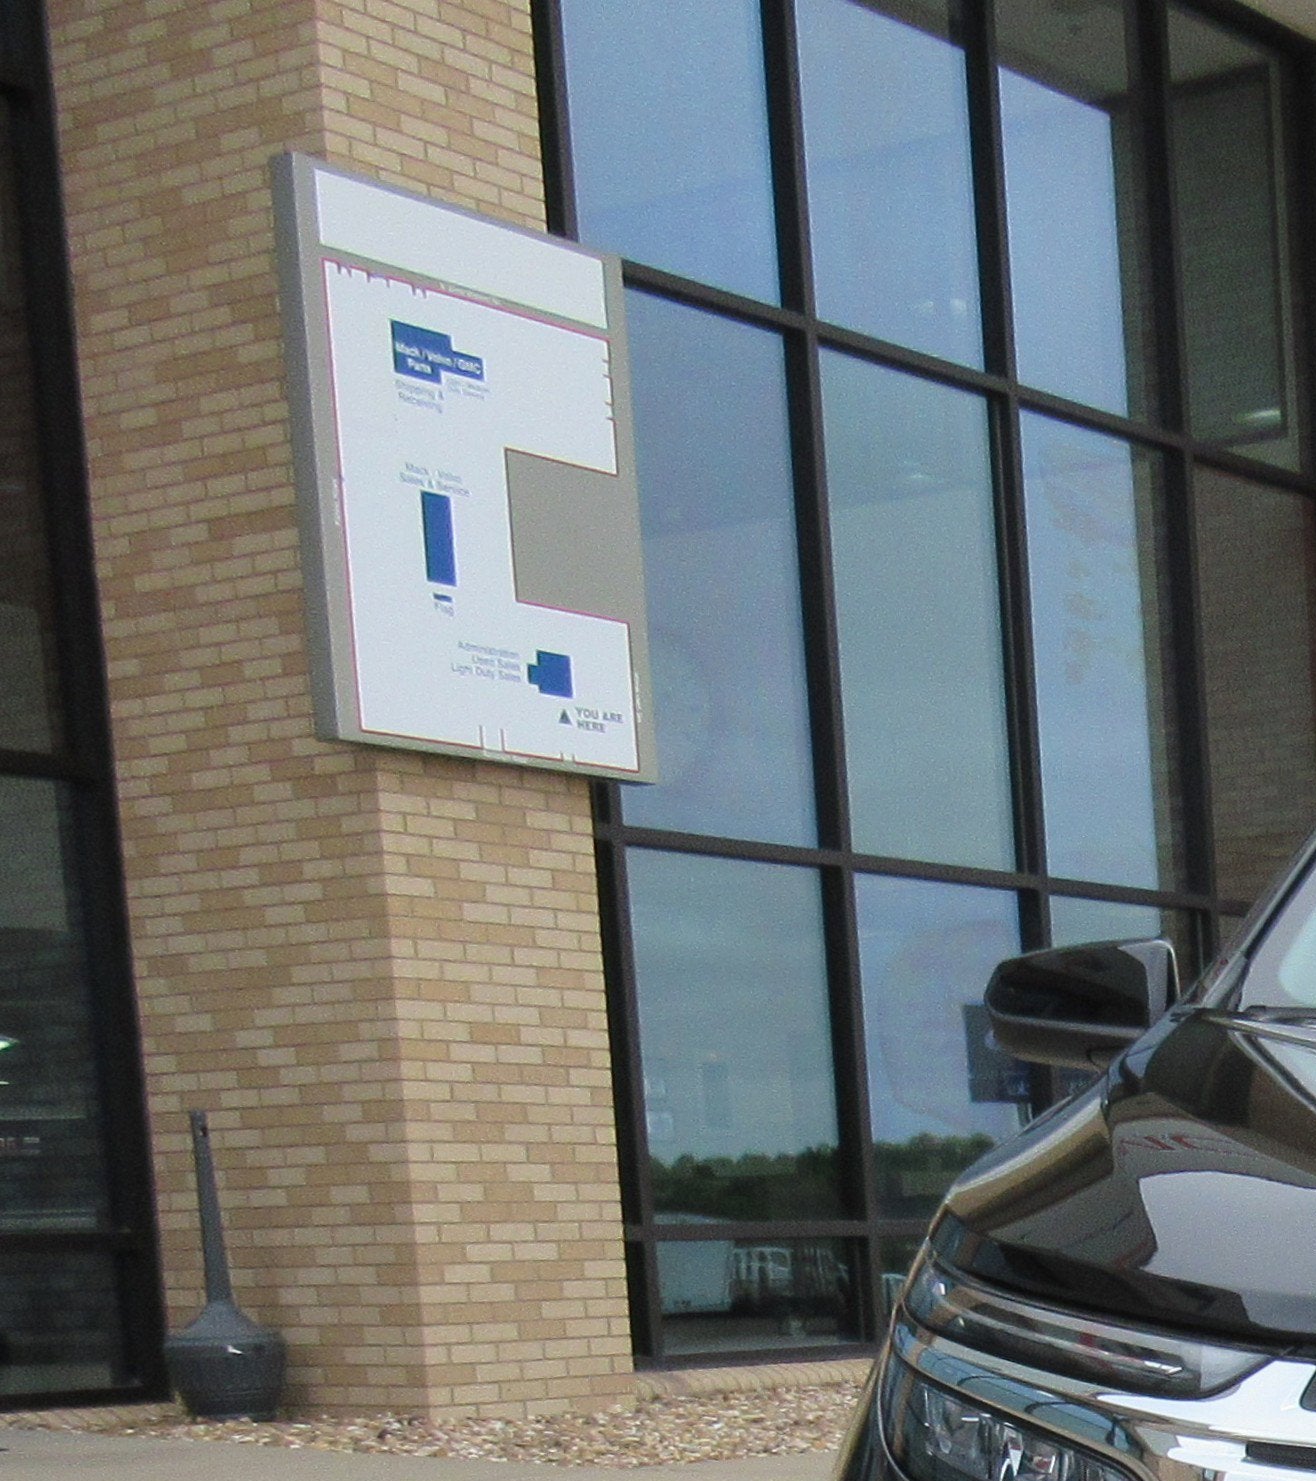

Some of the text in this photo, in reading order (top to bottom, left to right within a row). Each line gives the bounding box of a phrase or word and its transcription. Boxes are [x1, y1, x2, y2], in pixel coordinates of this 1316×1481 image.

[457, 358, 482, 375] GMC
[574, 705, 624, 724] YOU ARE
[576, 719, 606, 734] HERE
